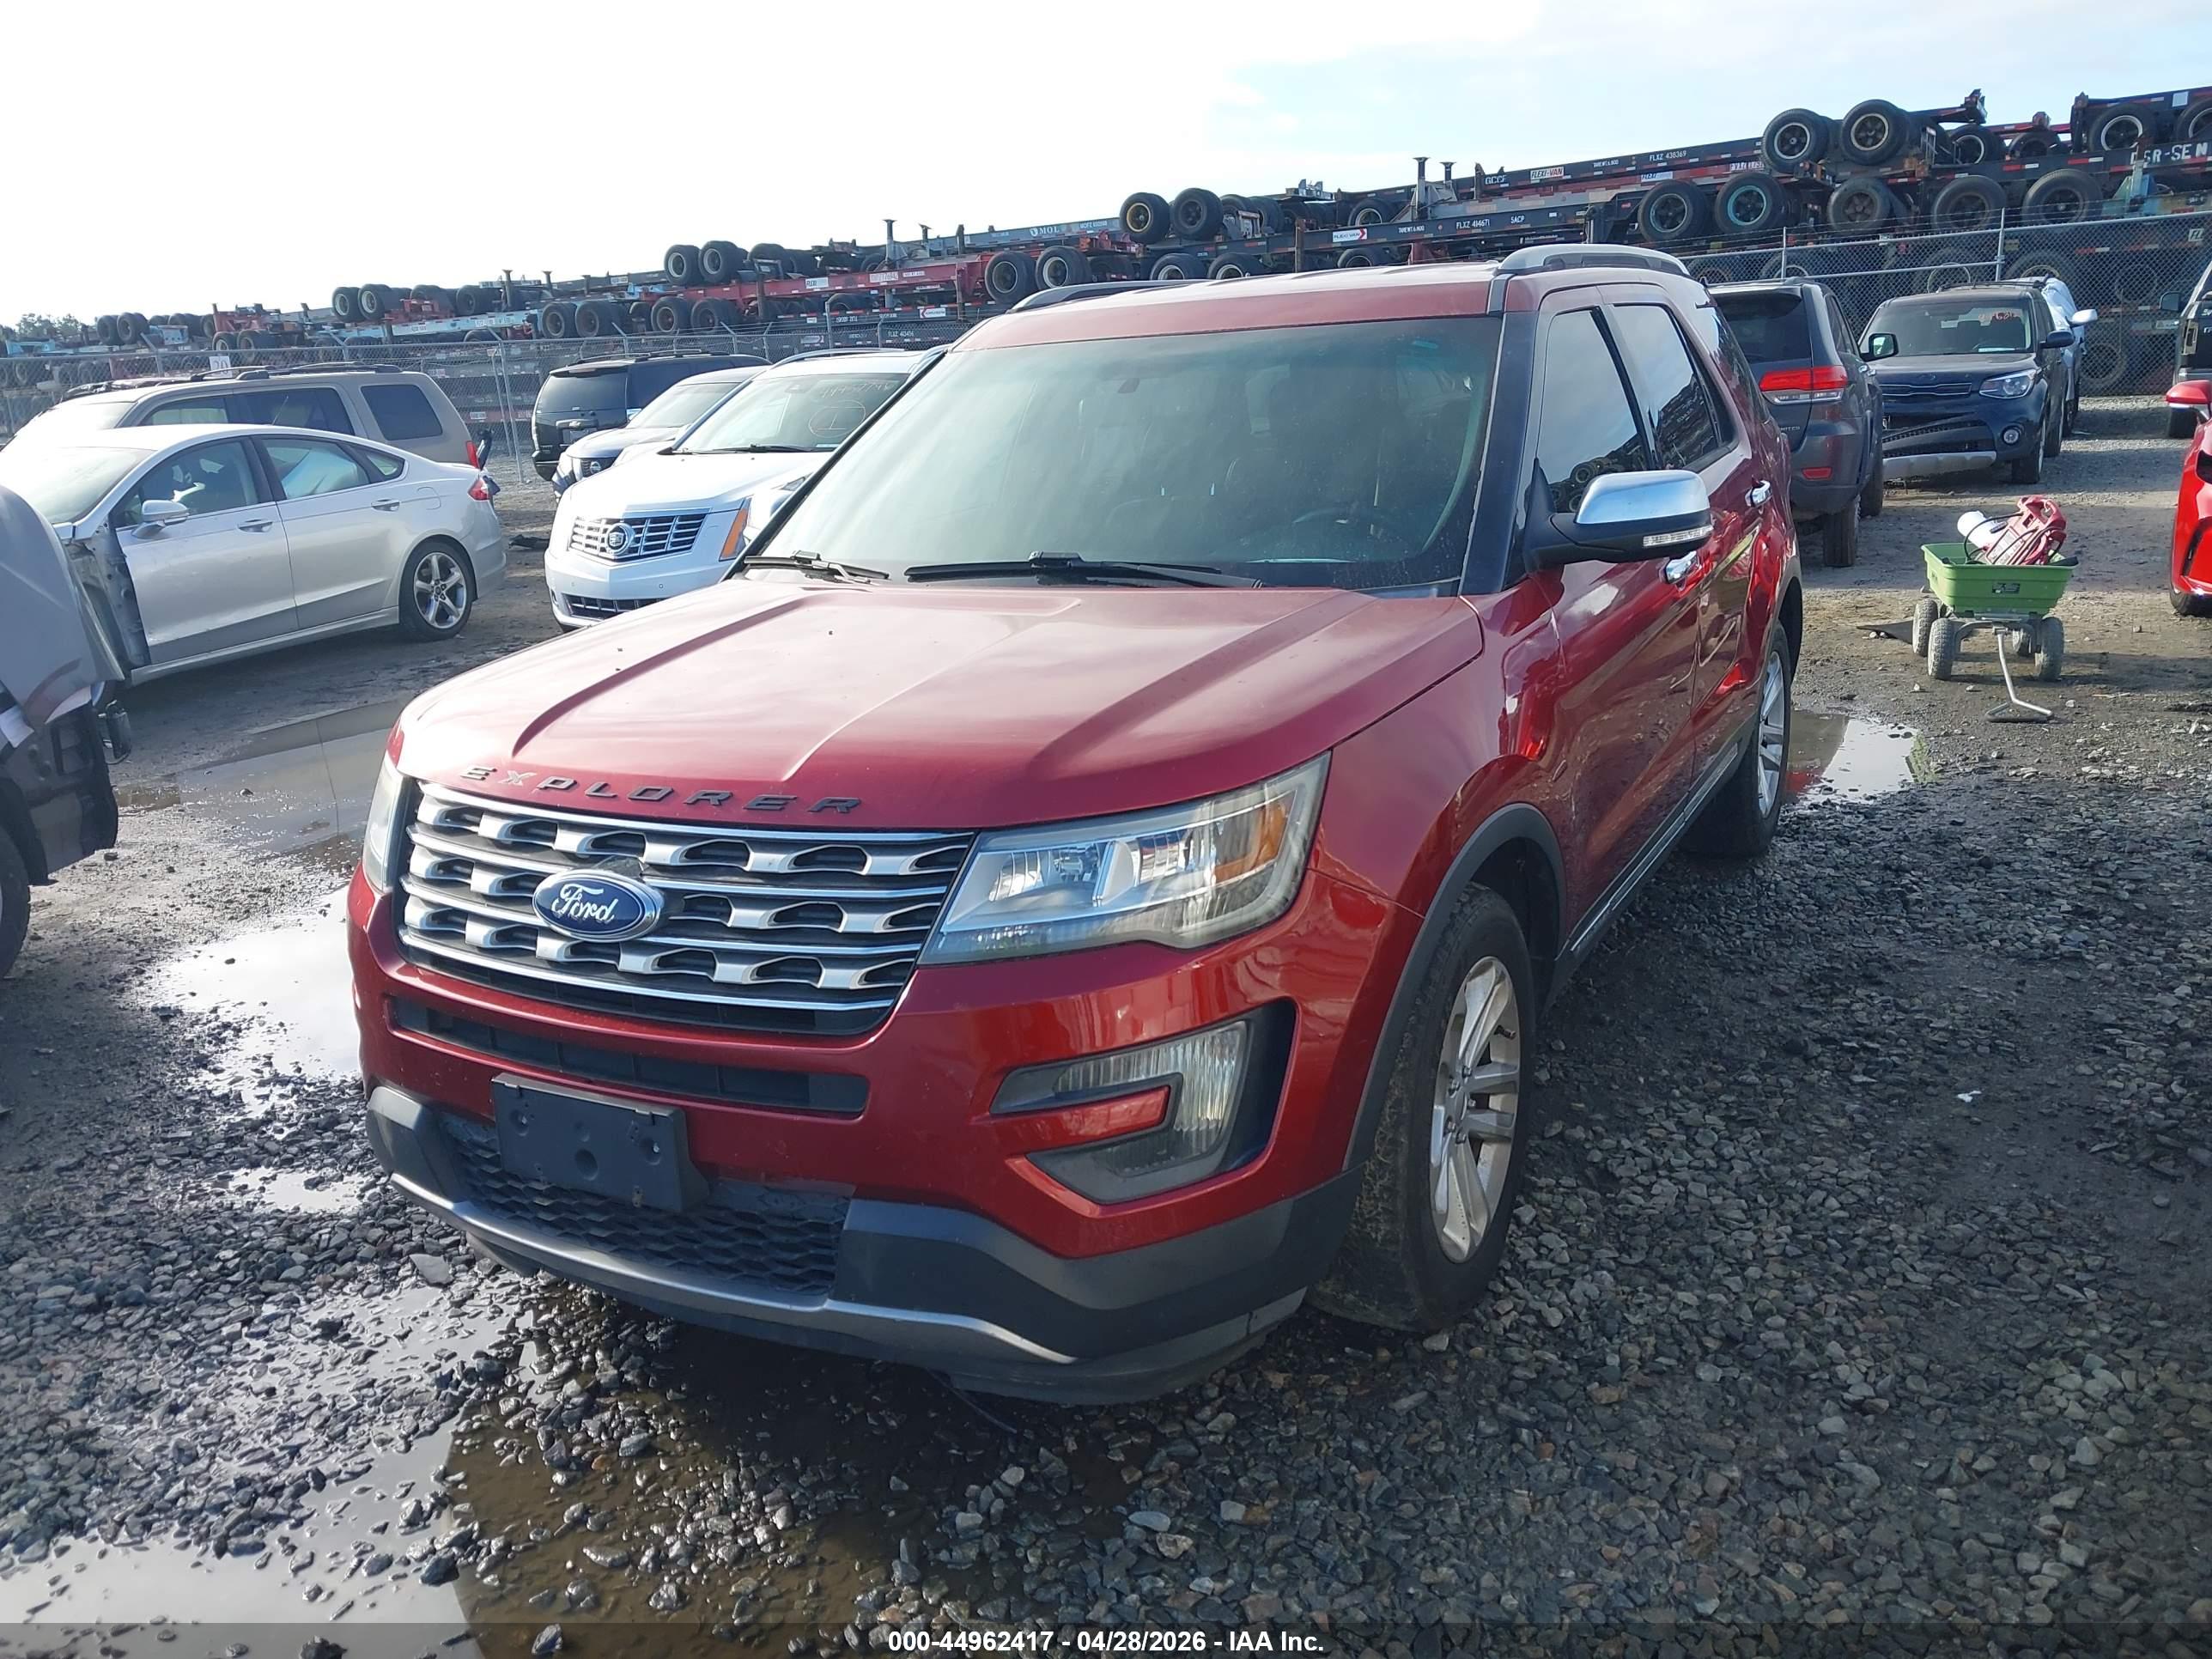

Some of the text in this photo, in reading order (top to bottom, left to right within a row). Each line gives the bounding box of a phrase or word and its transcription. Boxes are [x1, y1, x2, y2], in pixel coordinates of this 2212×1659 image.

[1666, 150, 1687, 160] 438369
[1531, 167, 1563, 179] FLEXI-VAN
[1455, 218, 1491, 229] FLXZ 414671
[1039, 225, 1060, 235] MOL
[459, 766, 862, 815] EXPLORER
[550, 883, 620, 924] Ford
